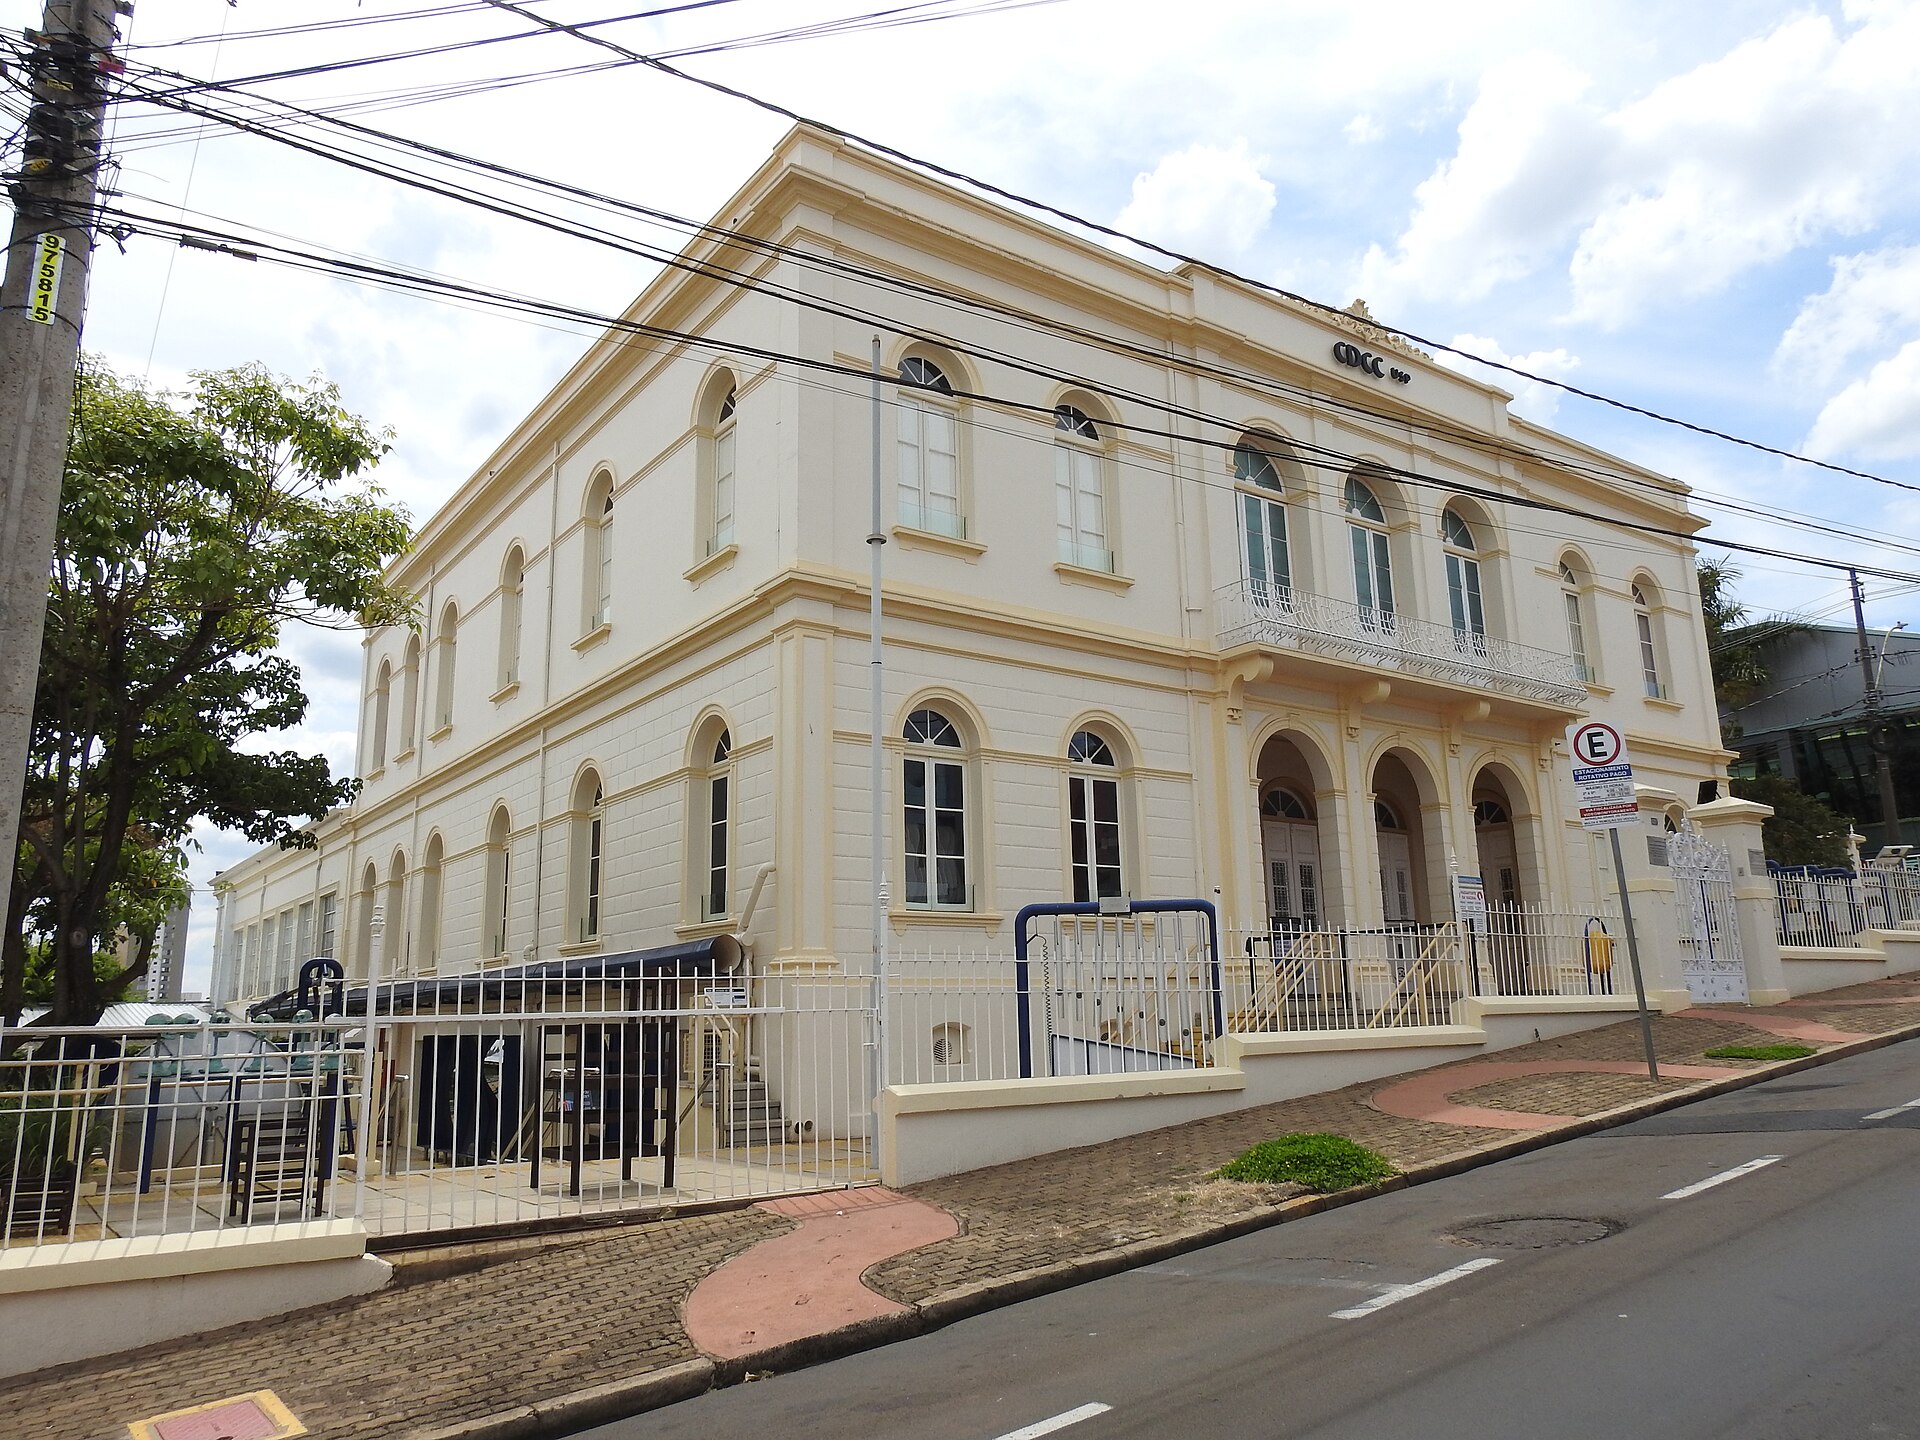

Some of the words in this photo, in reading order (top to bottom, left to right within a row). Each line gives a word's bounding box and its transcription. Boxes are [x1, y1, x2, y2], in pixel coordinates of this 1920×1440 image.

[34, 235, 60, 321] 975815
[1333, 341, 1385, 378] CDCC
[1587, 732, 1608, 758] E
[1574, 765, 1629, 775] ESTACIONAMENTO
